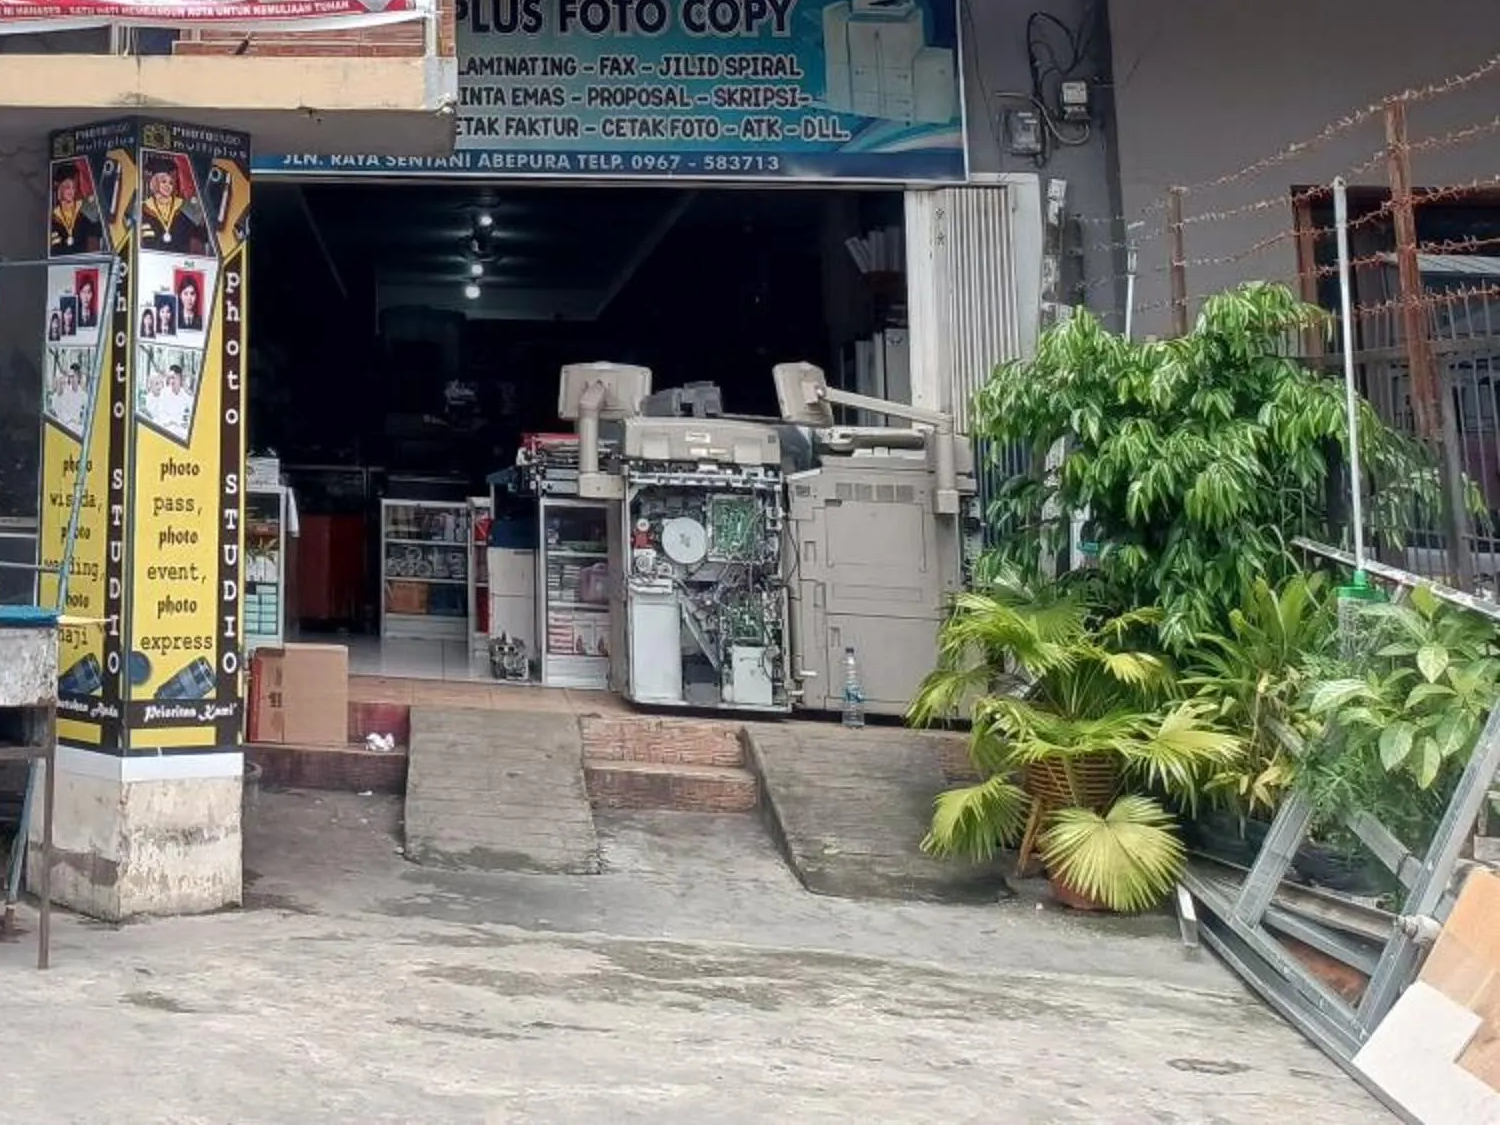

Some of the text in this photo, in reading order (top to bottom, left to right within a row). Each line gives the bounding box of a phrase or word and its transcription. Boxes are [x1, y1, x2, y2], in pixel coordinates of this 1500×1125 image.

[601, 56, 636, 76] FAX
[659, 56, 719, 76] JILID
[725, 56, 801, 76] SPIRAL
[456, 87, 506, 107] INTA
[511, 87, 565, 107] EMAS
[587, 87, 691, 107] PROPOSAL
[456, 117, 499, 136] ETAK
[505, 118, 578, 138] FAKTUR
[602, 118, 665, 138] CETAK
[671, 118, 719, 138] FOTO
[742, 118, 781, 138] ATK
[802, 118, 850, 139] DLL.
[477, 154, 571, 169] ABEPURA
[577, 155, 625, 170] TELP.
[631, 156, 681, 170] 0967
[703, 156, 780, 171] 583713
[225, 272, 240, 424] photo
[63, 455, 92, 477] phoo
[160, 457, 201, 481] photo
[50, 491, 103, 513] wisda,
[153, 496, 203, 517] pass,
[61, 526, 91, 545] poto
[158, 525, 199, 550] photo
[147, 563, 208, 583] event,
[222, 474, 238, 674] STUDIO
[66, 592, 90, 609] hoto
[157, 594, 198, 620] photo
[140, 635, 214, 656] express
